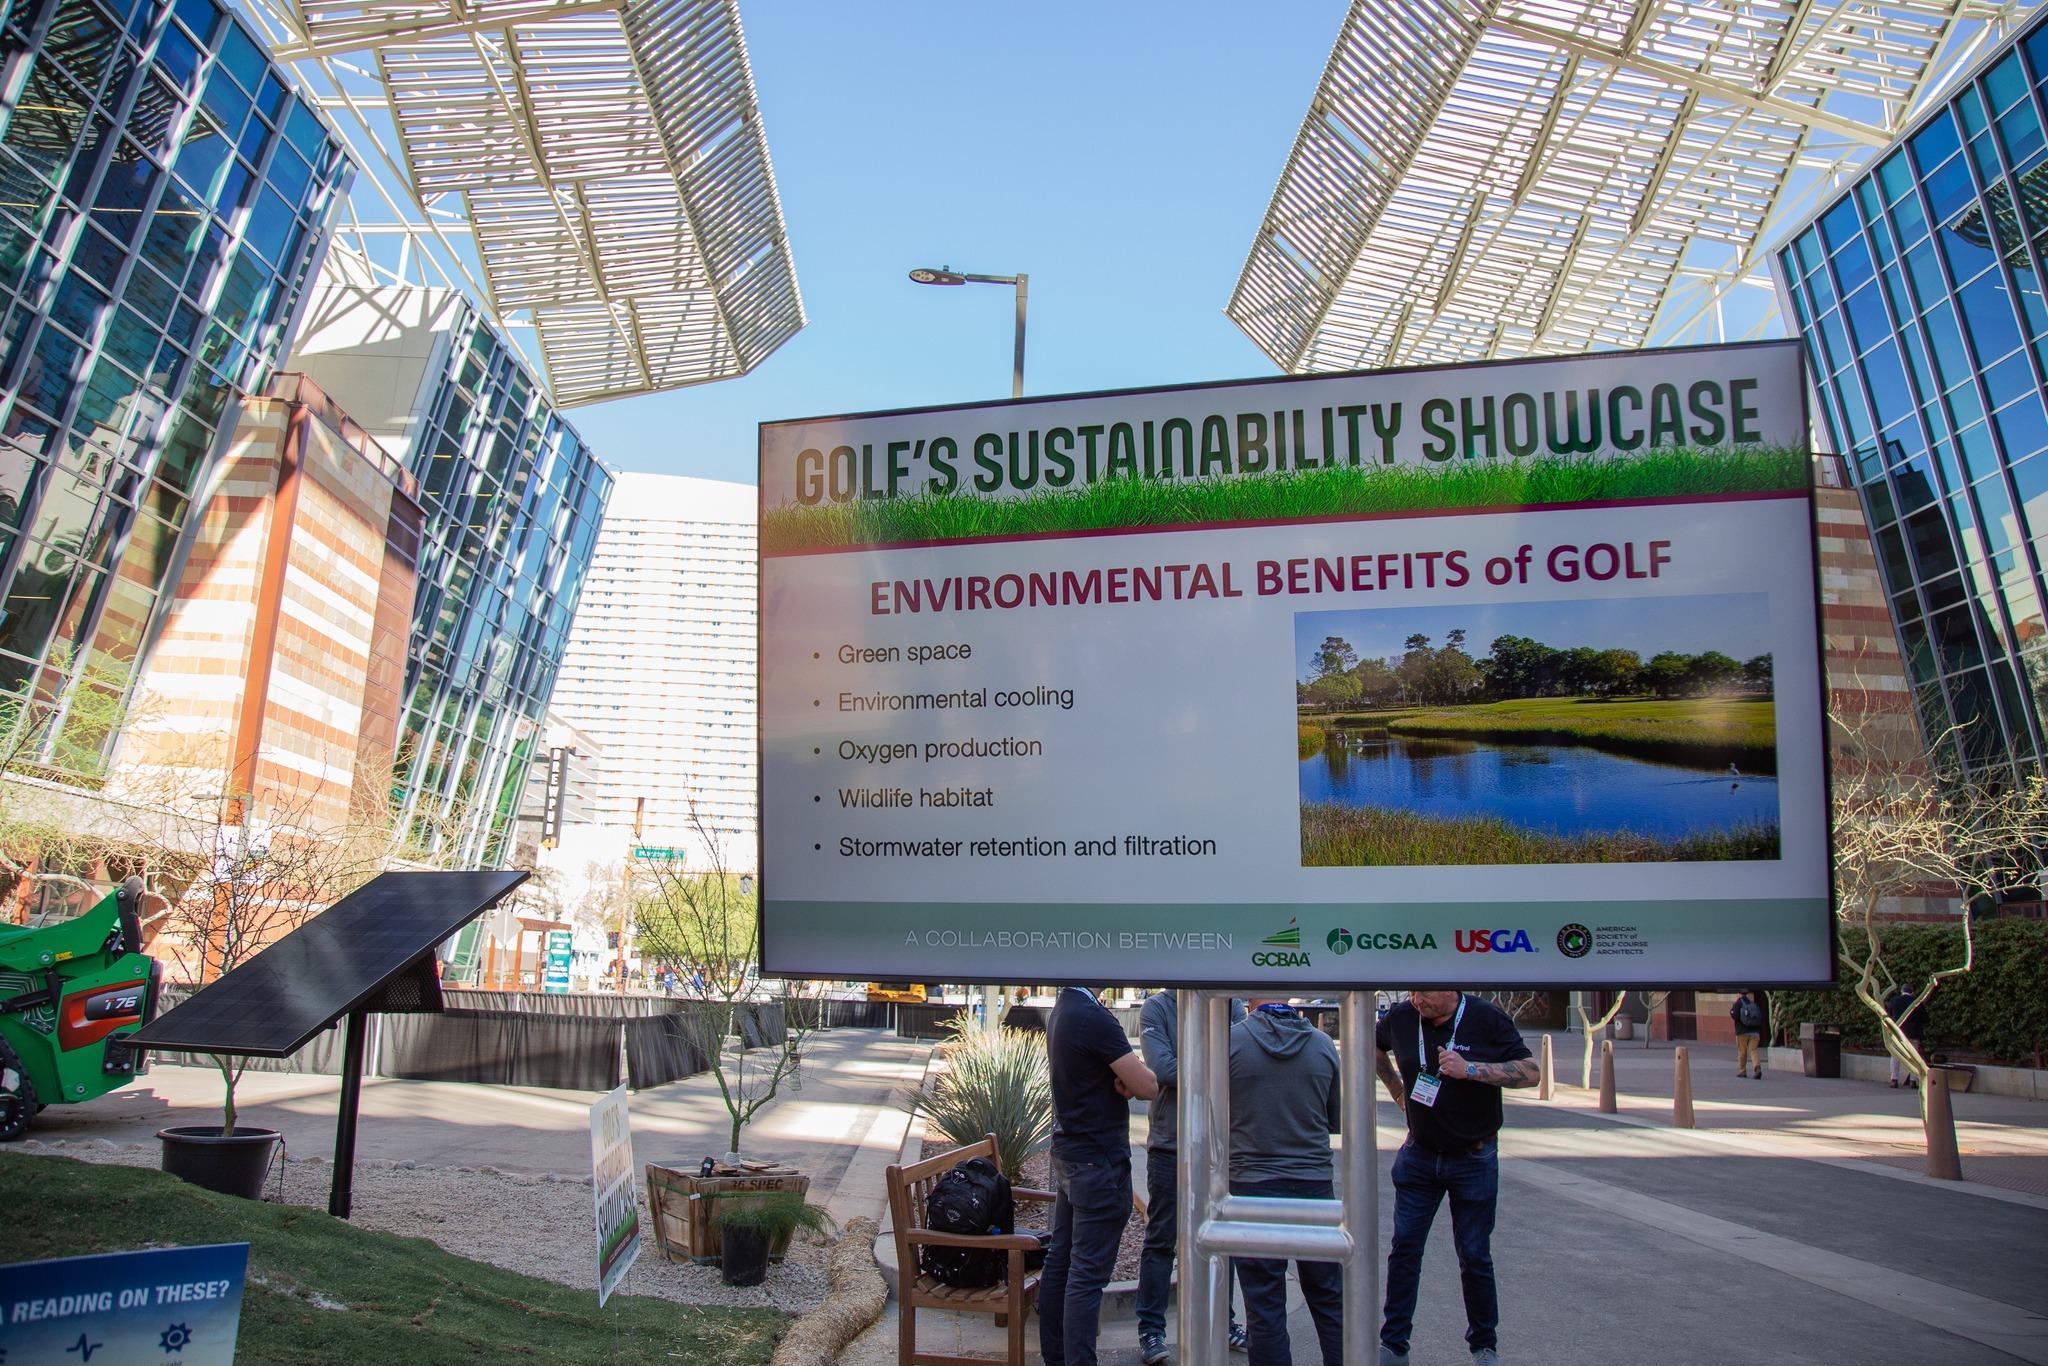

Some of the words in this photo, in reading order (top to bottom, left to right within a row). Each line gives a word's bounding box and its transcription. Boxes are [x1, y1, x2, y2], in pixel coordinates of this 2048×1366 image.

[796, 437, 959, 506] GOLF'S
[973, 402, 1402, 493] SUSTAINABILITY
[1420, 378, 1763, 463] SHOWCASE
[871, 562, 1243, 616] ENVIRONMENTAL
[1257, 550, 1470, 597] BENEFITS
[1484, 544, 1533, 586] of
[1547, 540, 1672, 583] GOLF
[838, 644, 900, 664] Green
[907, 643, 972, 665] space
[838, 688, 987, 712] Environmental
[994, 686, 1074, 710] cooling
[838, 740, 917, 764] Oxygen
[925, 737, 1042, 762] production
[838, 788, 913, 808] Wildlife
[920, 787, 994, 807] habitat
[839, 837, 963, 857] Stormwater
[969, 836, 1067, 856] retention
[1074, 836, 1116, 856] and
[1123, 835, 1217, 856] filtration
[904, 930, 919, 946] A
[925, 930, 1111, 949] COLLABORATION
[1119, 932, 1233, 950] BETWEEN
[1356, 933, 1438, 950] GCSAA
[1455, 929, 1534, 953] USGA
[1252, 952, 1311, 967] GCBAA
[599, 1172, 636, 1252] SHOWCASE
[12, 1292, 112, 1323] READING
[119, 1288, 149, 1309] ON
[155, 1279, 230, 1305] THESE?
